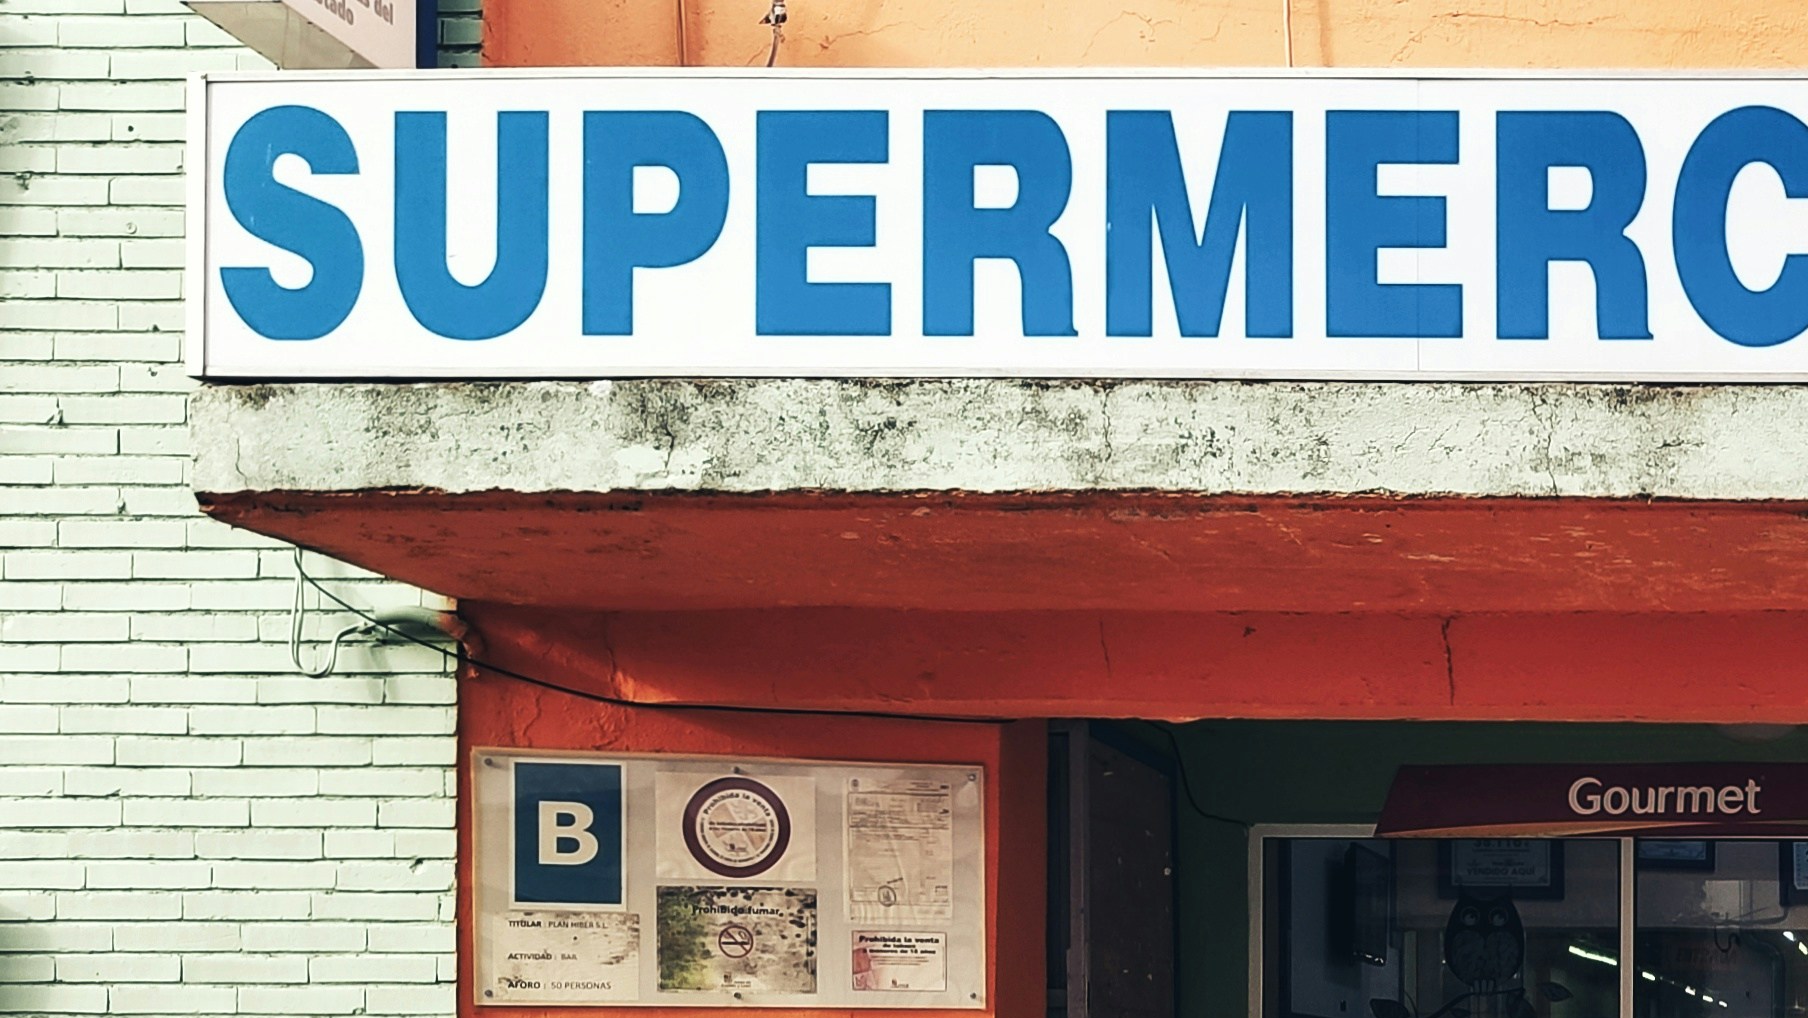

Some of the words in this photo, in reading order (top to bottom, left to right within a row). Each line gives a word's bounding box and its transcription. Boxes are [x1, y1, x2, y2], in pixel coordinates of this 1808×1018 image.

[1569, 777, 1760, 815] Gourmet
[539, 801, 599, 865] B
[859, 935, 901, 943] Prohibida
[551, 981, 562, 989] 50
[564, 981, 612, 990] PERSONAS
